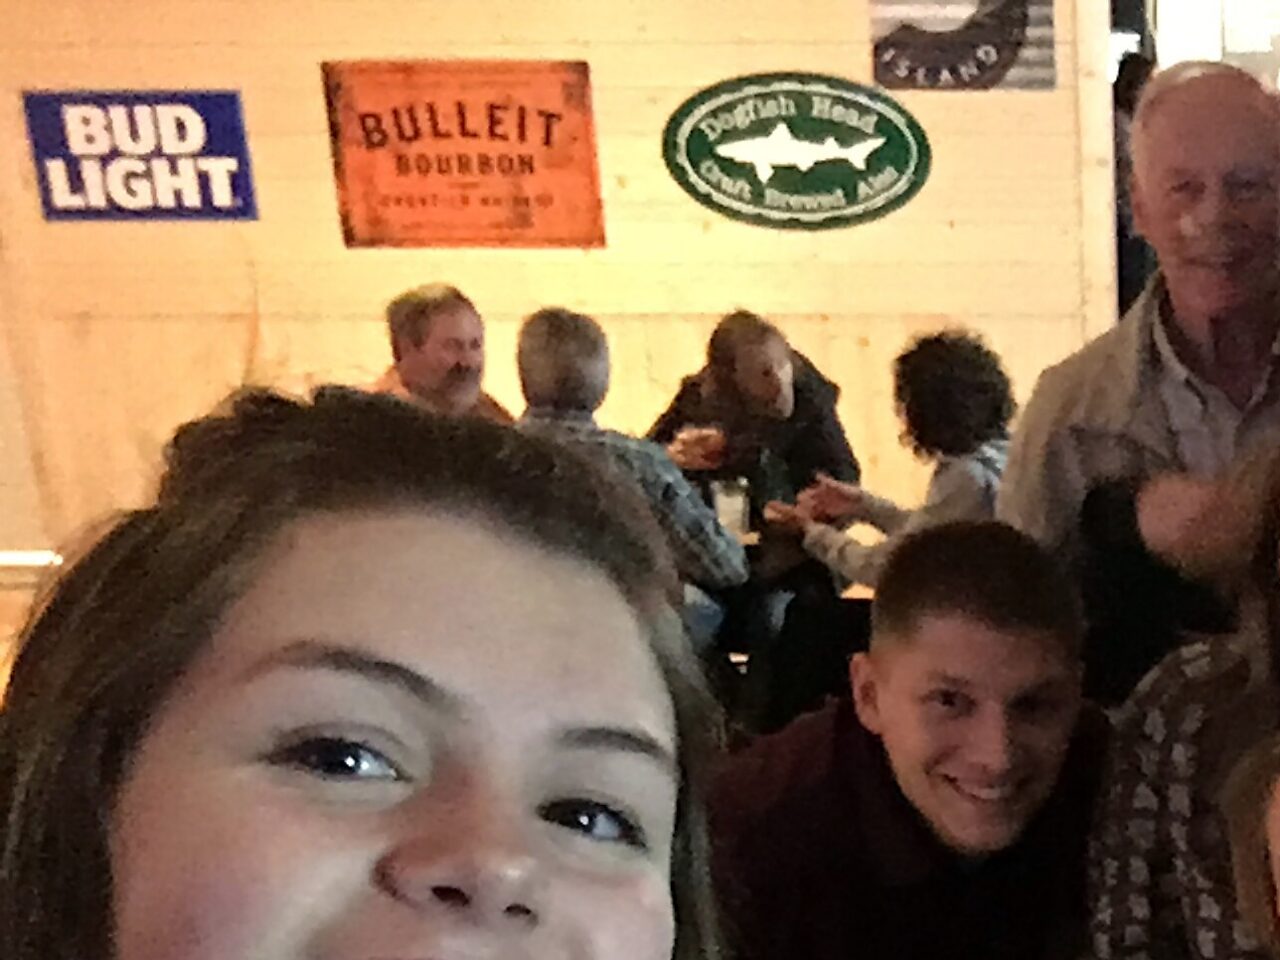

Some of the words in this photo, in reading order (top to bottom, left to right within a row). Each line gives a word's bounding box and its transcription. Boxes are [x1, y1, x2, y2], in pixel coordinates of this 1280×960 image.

[61, 103, 207, 156] BUD
[358, 100, 562, 150] BULLEIT
[44, 156, 239, 210] LIGHT
[394, 153, 535, 177] BOURBON
